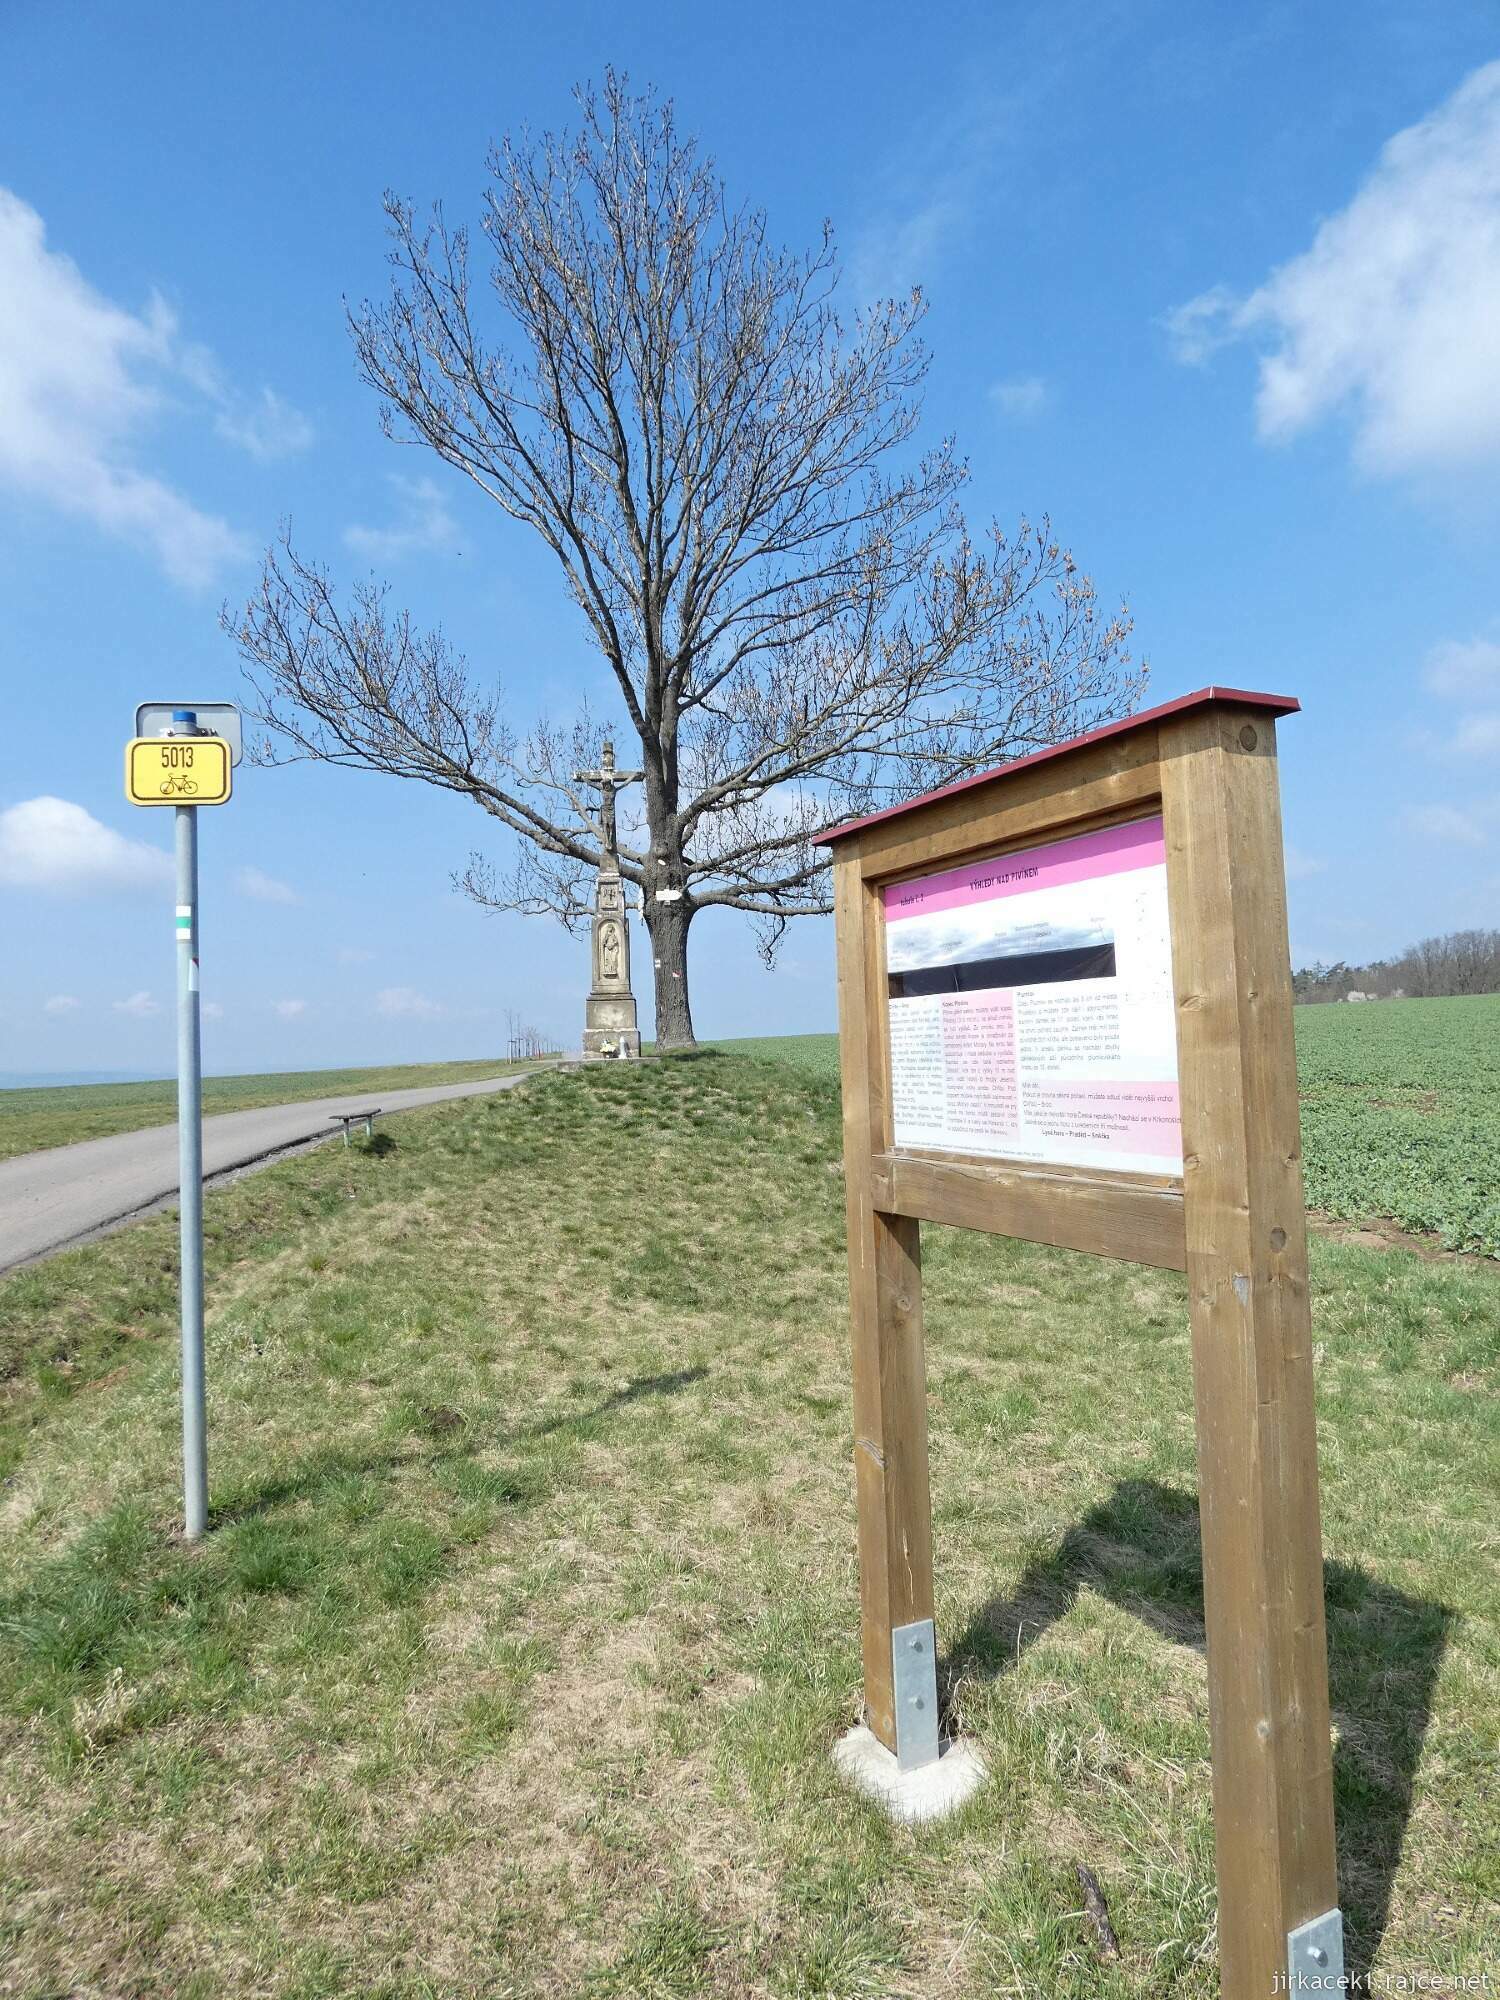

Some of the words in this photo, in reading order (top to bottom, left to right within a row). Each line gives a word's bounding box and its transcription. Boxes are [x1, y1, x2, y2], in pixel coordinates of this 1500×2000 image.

[161, 746, 194, 768] 5013
[969, 877, 994, 891] VÝHLEDY
[997, 873, 1010, 885] NAD
[1011, 867, 1039, 882] PIVÍNEM
